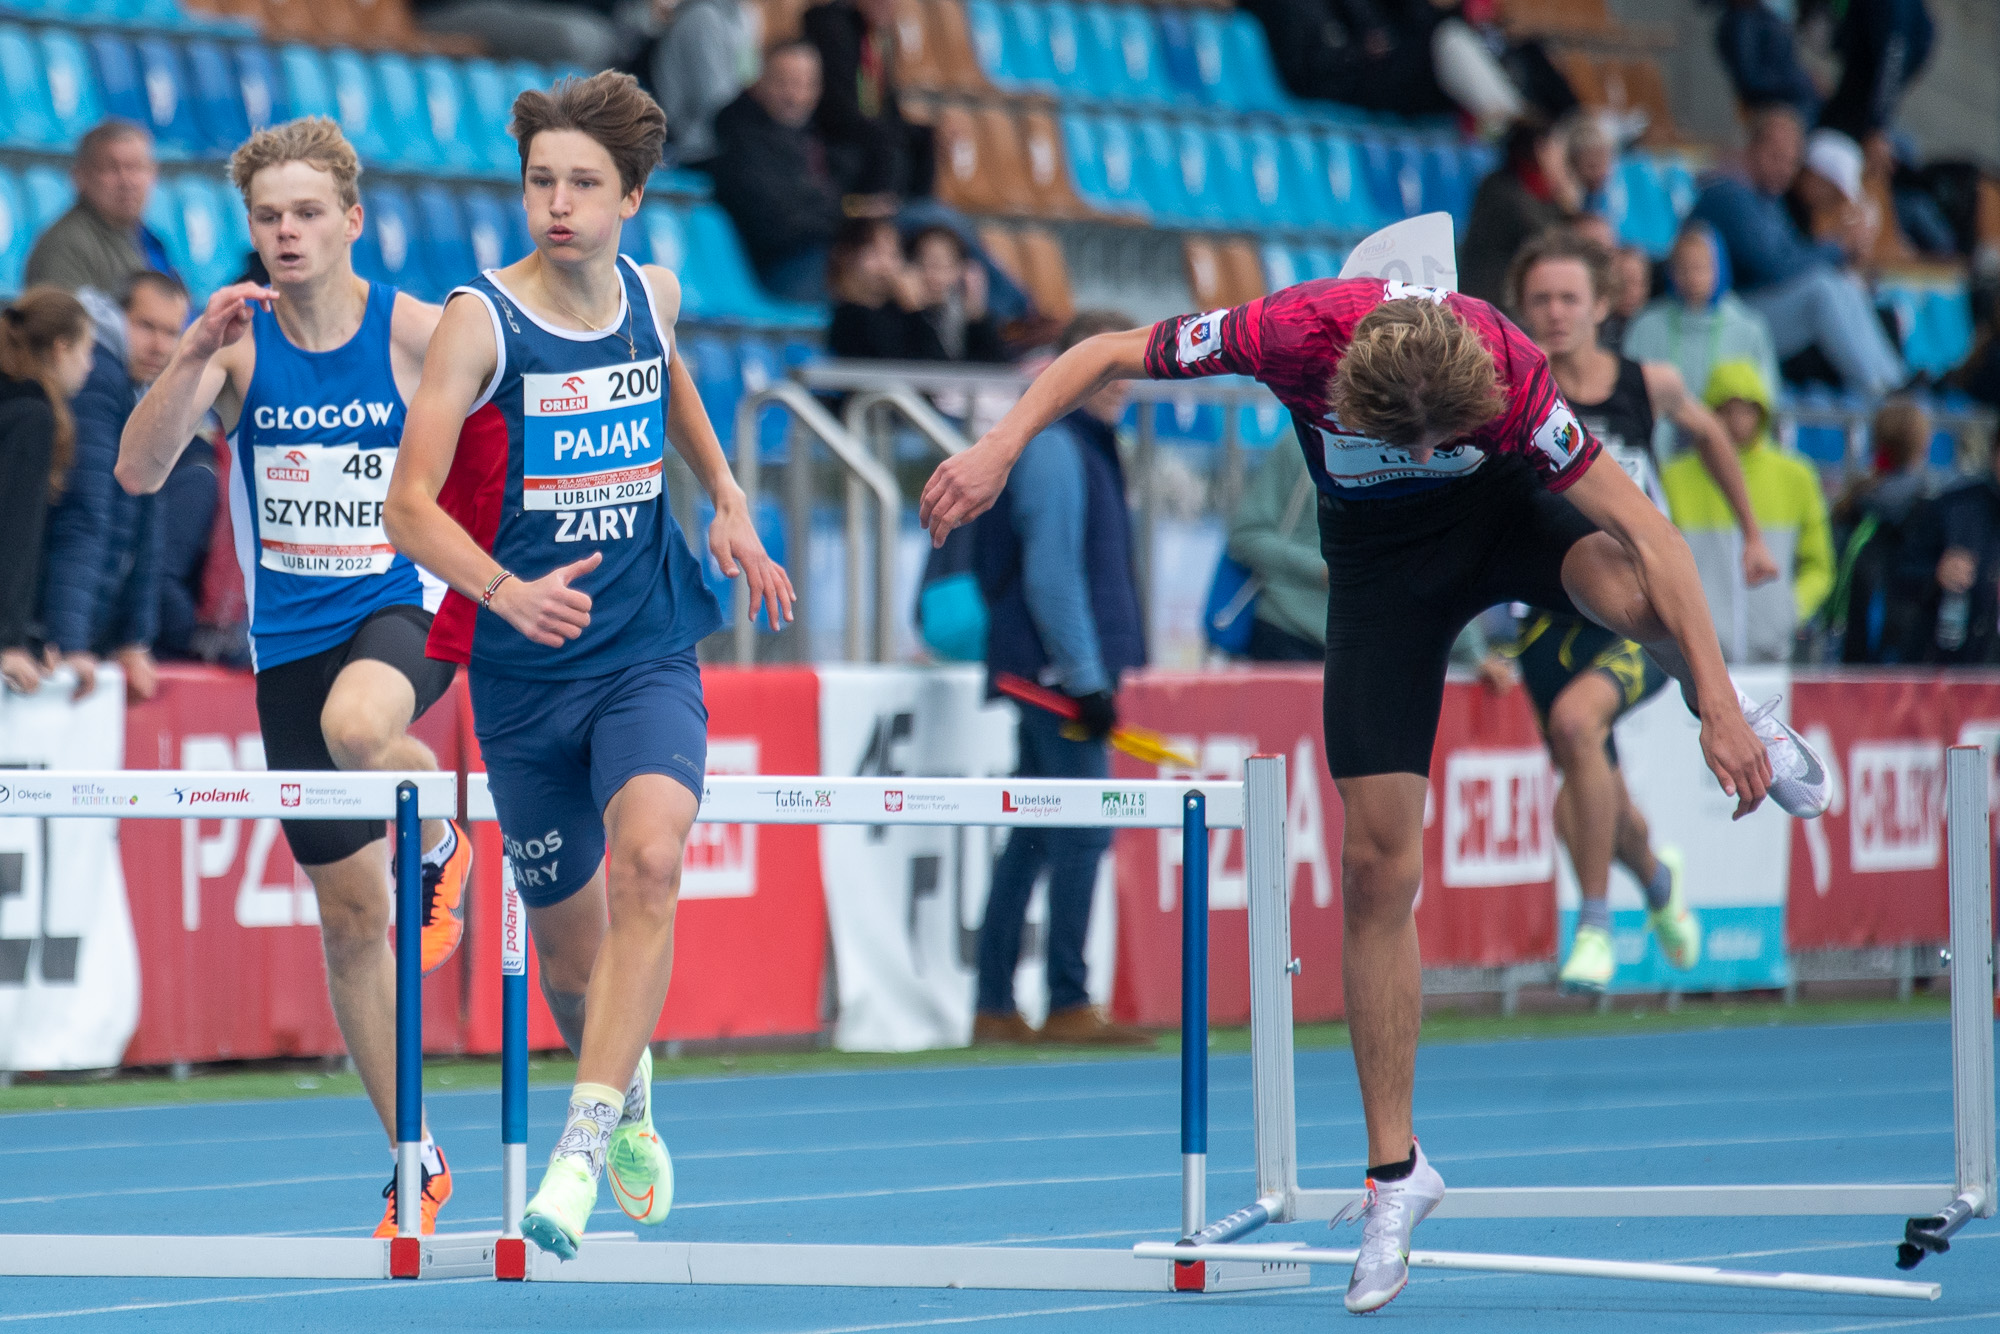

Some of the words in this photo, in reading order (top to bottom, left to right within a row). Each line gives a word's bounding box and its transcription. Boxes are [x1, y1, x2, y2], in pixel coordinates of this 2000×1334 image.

[608, 364, 659, 402] 200
[542, 397, 586, 411] ORLEN
[254, 398, 394, 430] GŁOGÓW
[553, 417, 651, 461] PAJĄK
[342, 453, 382, 480] 48
[269, 469, 308, 481] ORLEN
[555, 487, 610, 505] LUBLIN
[616, 480, 652, 498] 2022
[281, 555, 329, 570] LUBLIN
[335, 557, 373, 571] 2022
[17, 789, 52, 801] Okęcie
[189, 788, 250, 806] polanik
[305, 787, 347, 795] Ministerstwo
[775, 790, 813, 807] lublin
[305, 797, 327, 806] Sportu
[1014, 795, 1061, 805] lubelskie
[1122, 793, 1144, 806] AZS
[504, 887, 519, 953] polanik
